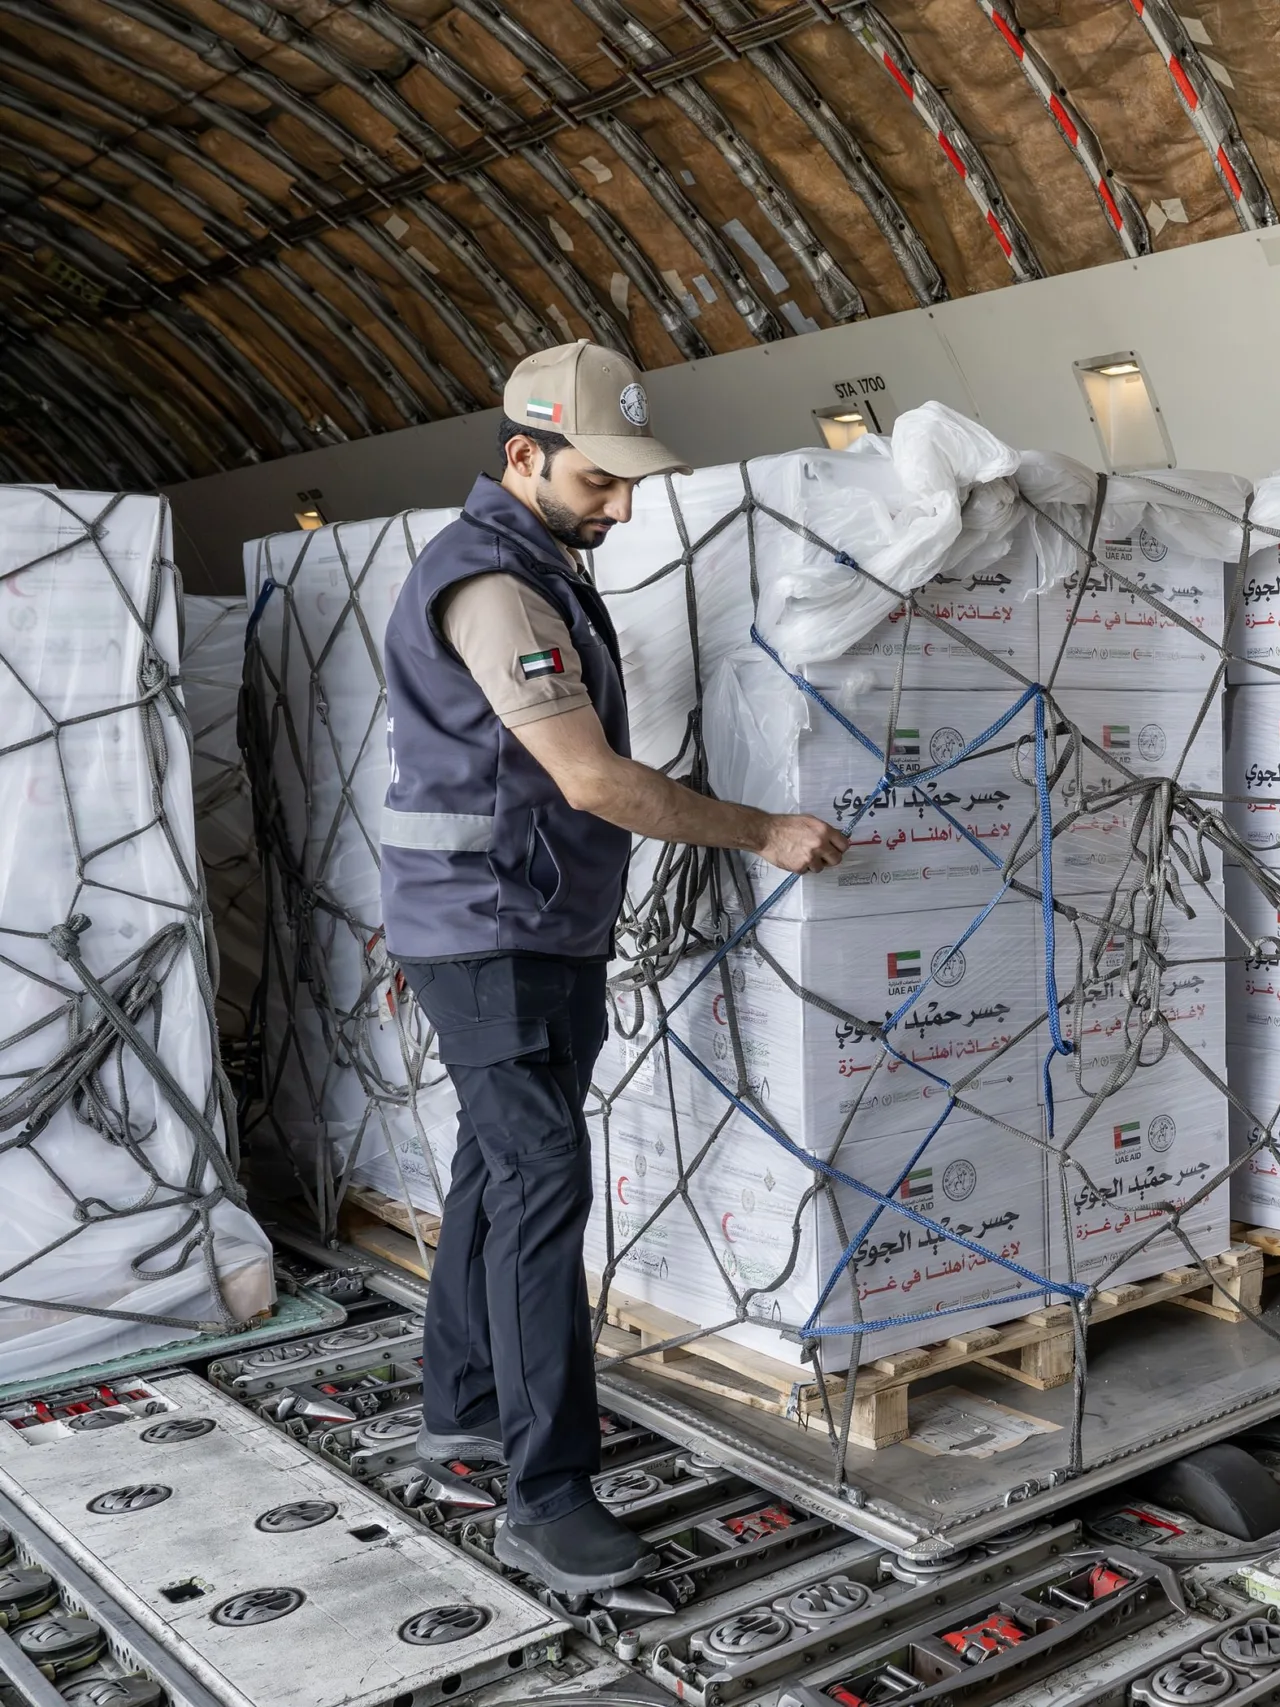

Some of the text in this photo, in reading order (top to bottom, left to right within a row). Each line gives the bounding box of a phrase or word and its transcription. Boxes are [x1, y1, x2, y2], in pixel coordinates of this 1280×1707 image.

[835, 375, 886, 398] STA 1700
[1105, 552, 1133, 561] UAE AID
[1245, 612, 1275, 629] غزة
[906, 763, 920, 772] AID
[961, 790, 1011, 811] جسر
[886, 828, 906, 850] في
[888, 986, 905, 995] UAE
[961, 1003, 1011, 1027] جسر
[1115, 1155, 1129, 1164] UAE
[1130, 1152, 1141, 1161] AID
[1173, 1162, 1210, 1186] جسر
[920, 1201, 934, 1211] AID
[973, 1211, 1020, 1238] جسر
[1076, 1217, 1112, 1240] غزة
[1114, 1212, 1130, 1233] في
[901, 1269, 921, 1292] في
